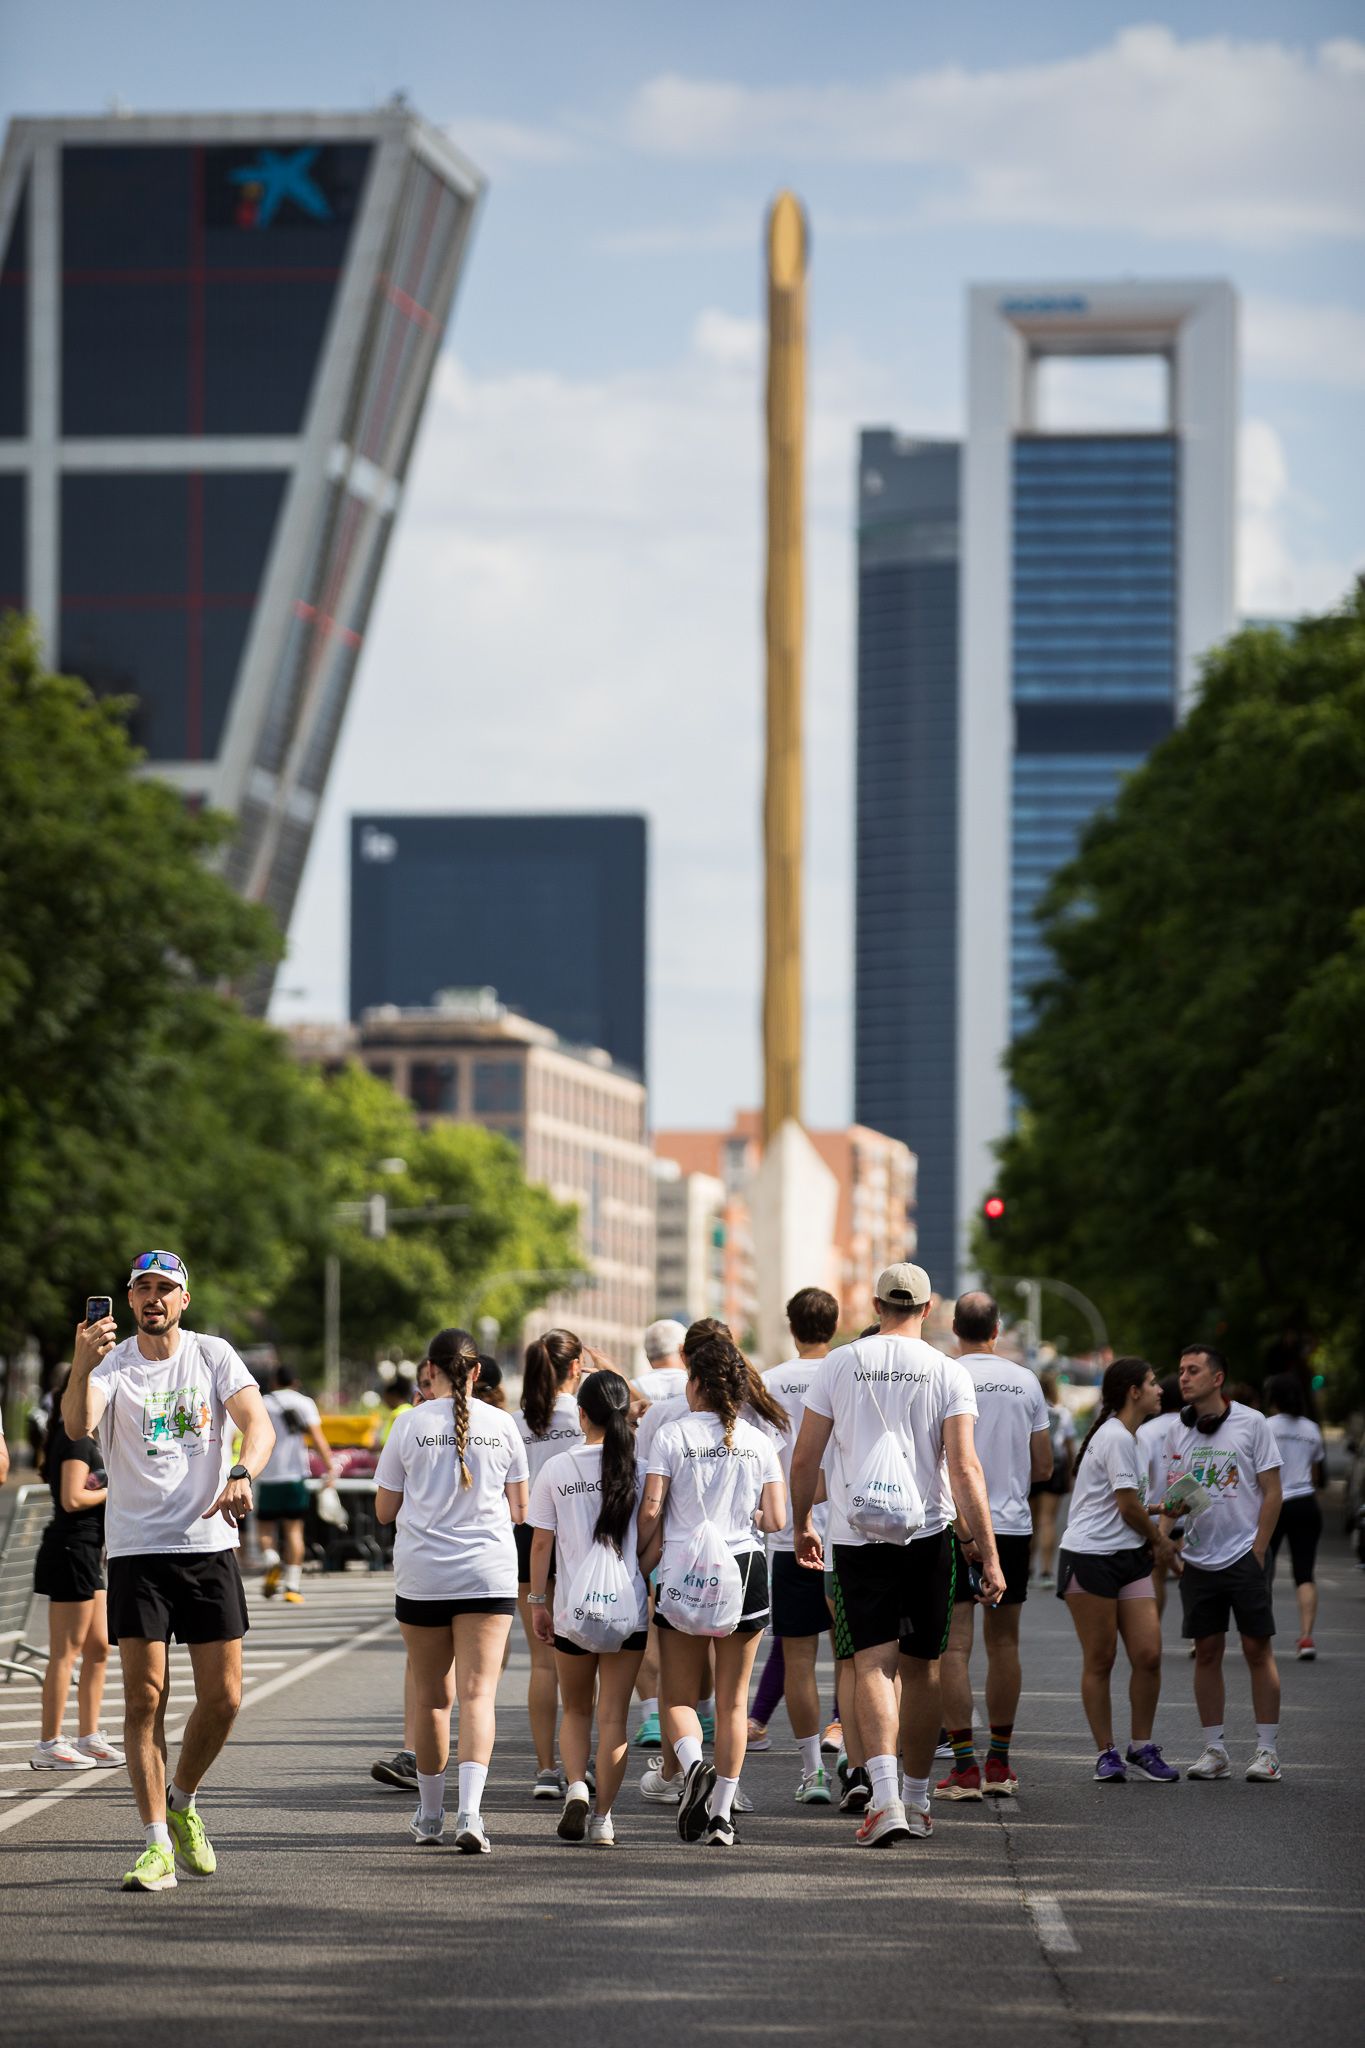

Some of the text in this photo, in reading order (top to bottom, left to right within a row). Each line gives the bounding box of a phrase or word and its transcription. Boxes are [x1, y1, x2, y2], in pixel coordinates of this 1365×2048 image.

[854, 1370, 929, 1384] VelillaGroup.
[416, 1434, 503, 1449] Velillaroup.
[681, 1446, 758, 1459] VelillaGroup.
